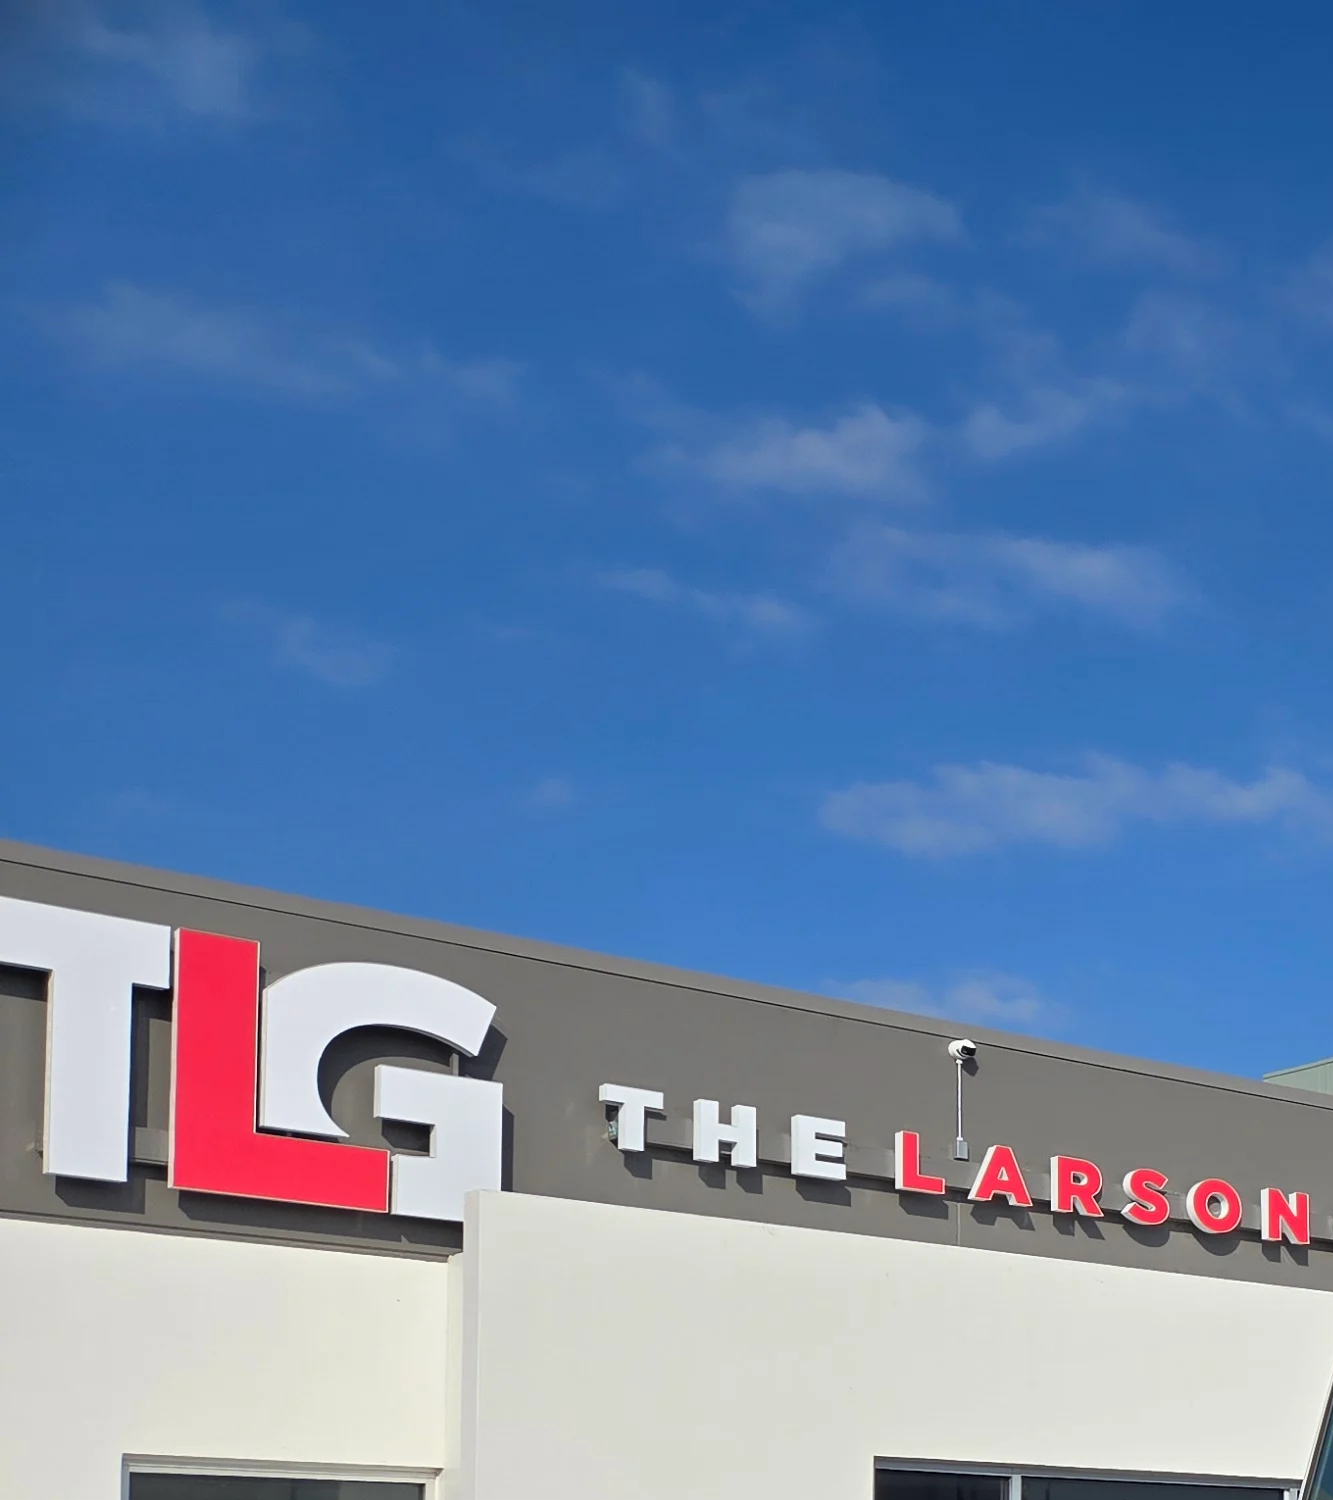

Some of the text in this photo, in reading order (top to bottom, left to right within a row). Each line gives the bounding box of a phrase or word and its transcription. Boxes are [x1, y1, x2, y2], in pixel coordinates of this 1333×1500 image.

[0, 896, 503, 1222] TLG
[599, 1083, 847, 1180] THE
[895, 1130, 1311, 1245] LARSON
